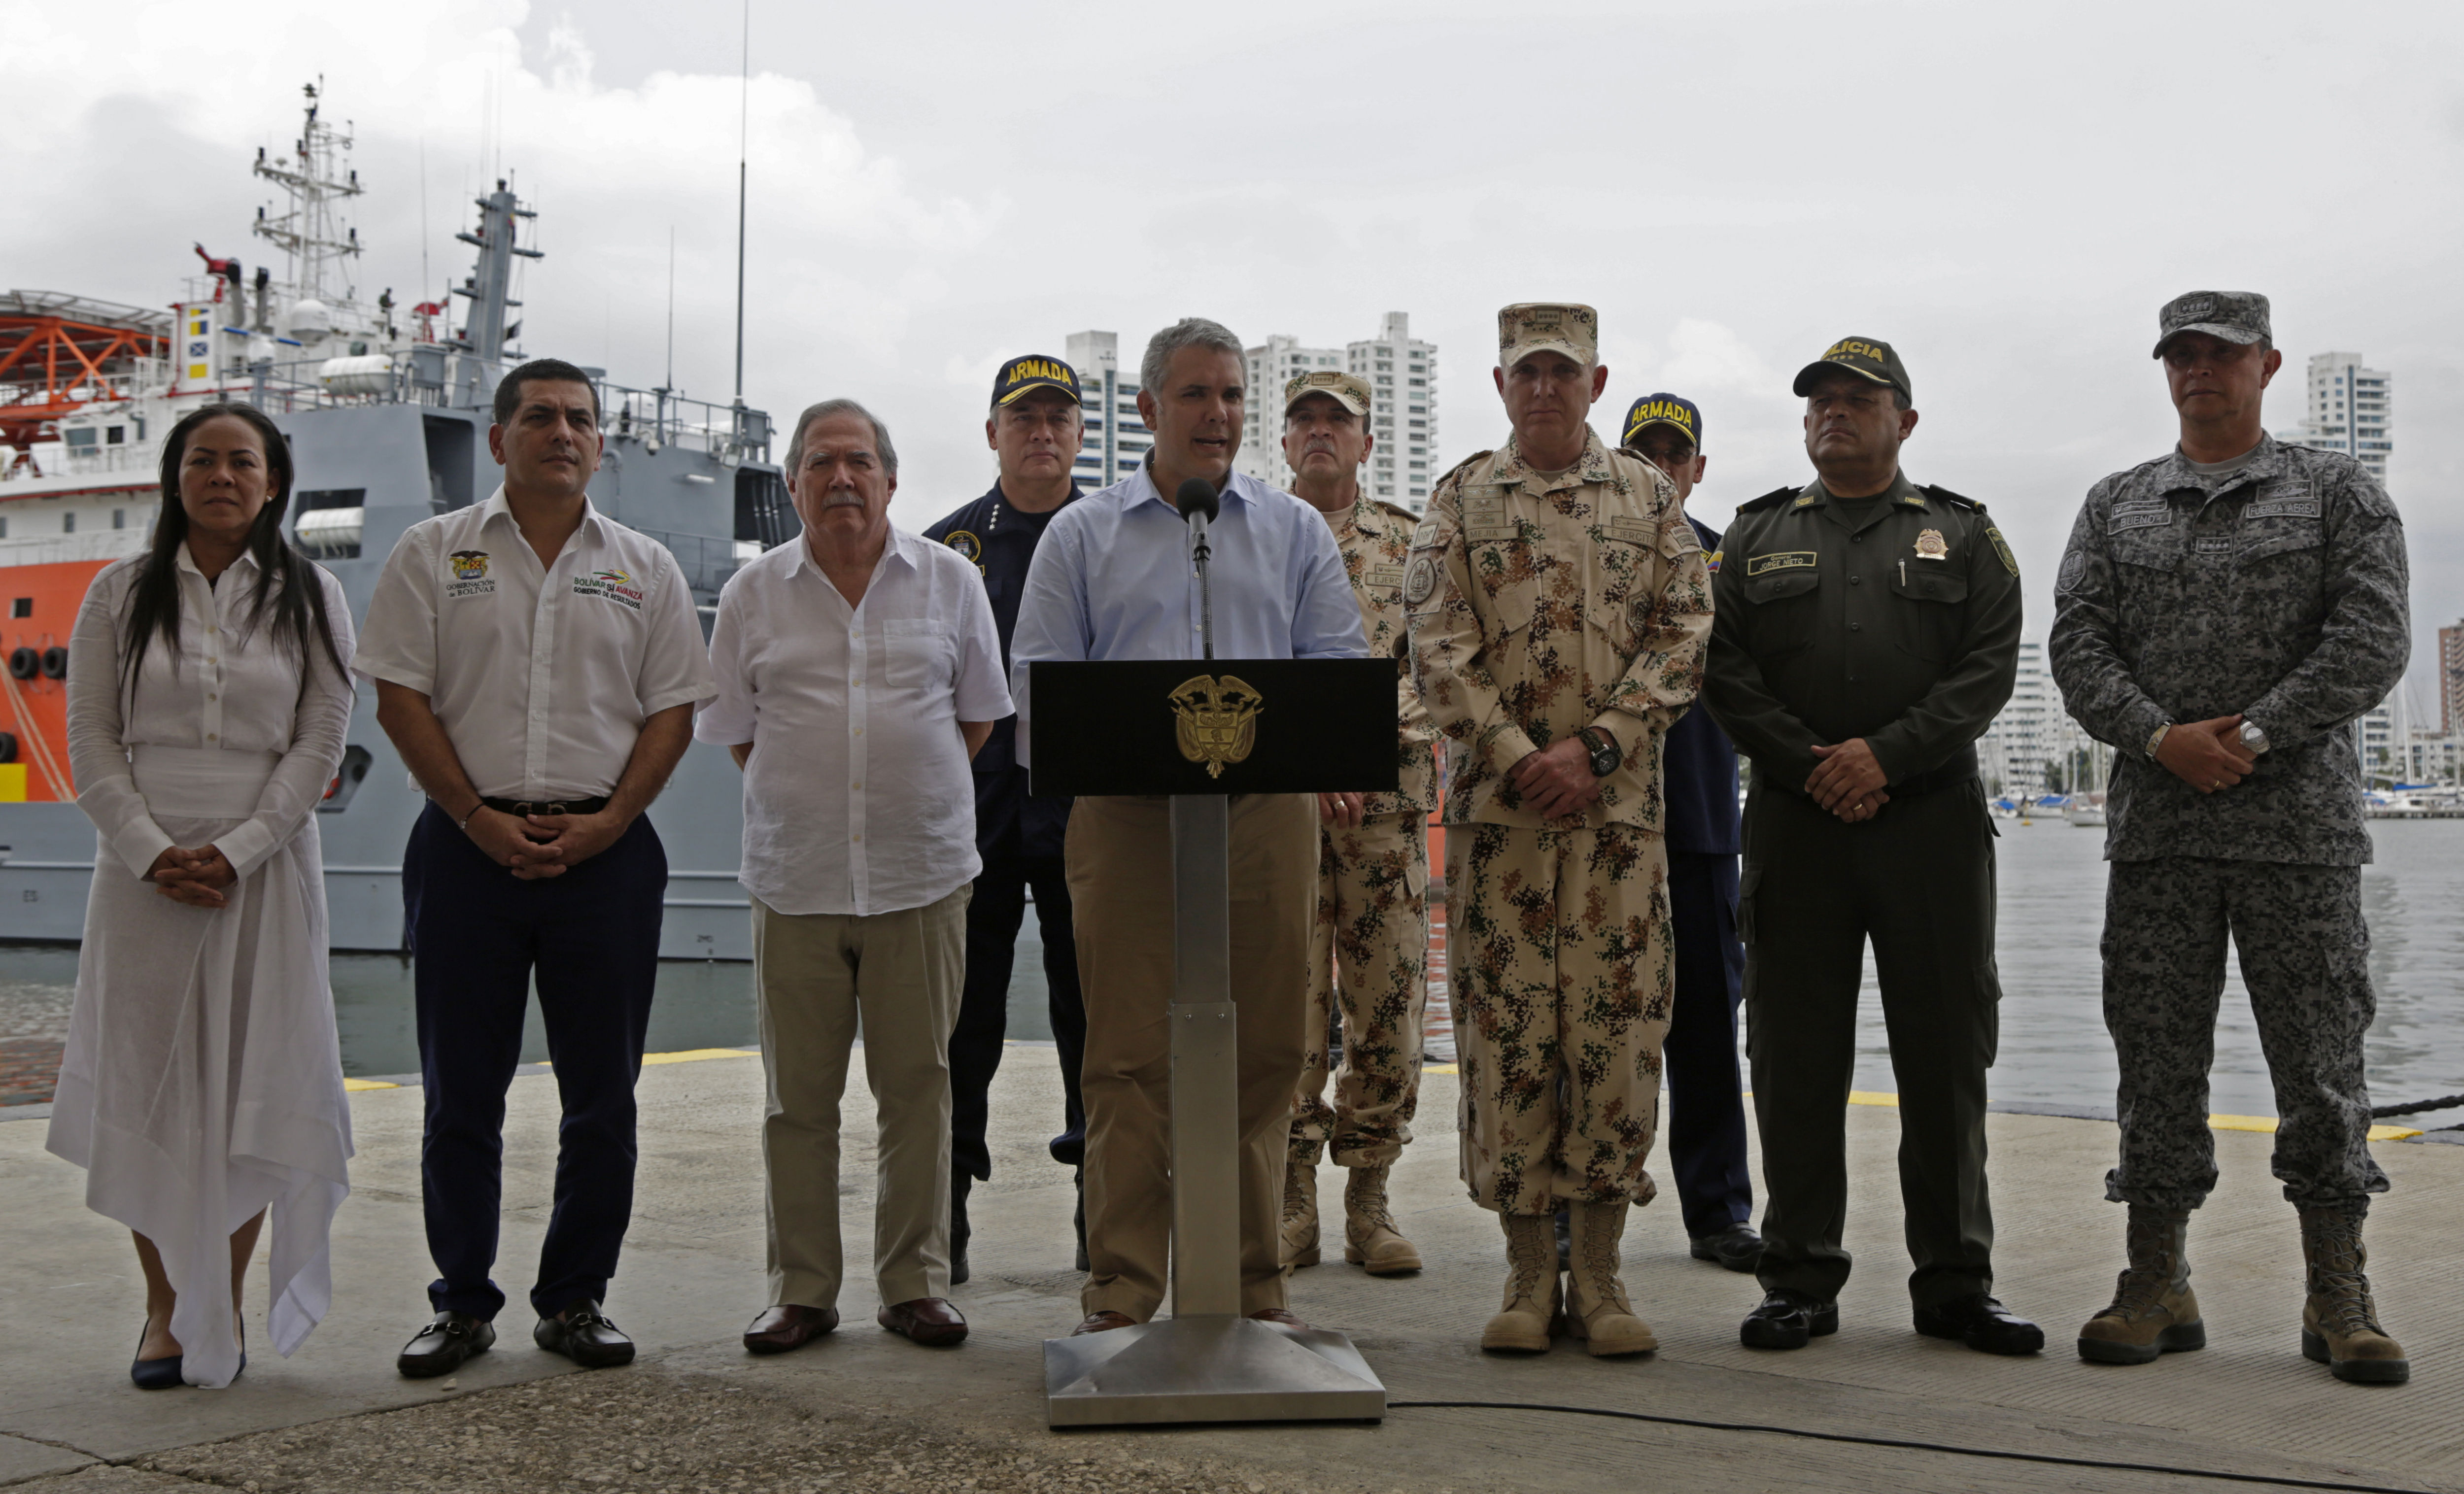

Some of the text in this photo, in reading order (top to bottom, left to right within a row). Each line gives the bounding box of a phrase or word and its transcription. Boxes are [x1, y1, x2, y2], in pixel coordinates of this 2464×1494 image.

[1006, 360, 1072, 386] ARMADA
[1632, 401, 1692, 428] ARMADA
[2251, 503, 2316, 515] FUERZA AEREA
[2121, 515, 2155, 527] BUENO
[1470, 530, 1498, 539] MEJIA
[1611, 529, 1656, 545] EJERCITO
[1759, 560, 1780, 570] JORGE
[446, 579, 495, 590] GOBERNACIÓN
[574, 577, 605, 588] BOLÍVAR
[616, 586, 643, 601] AVANZA
[574, 587, 601, 595] GOBIERNO
[611, 594, 640, 610] RESULTADOS
